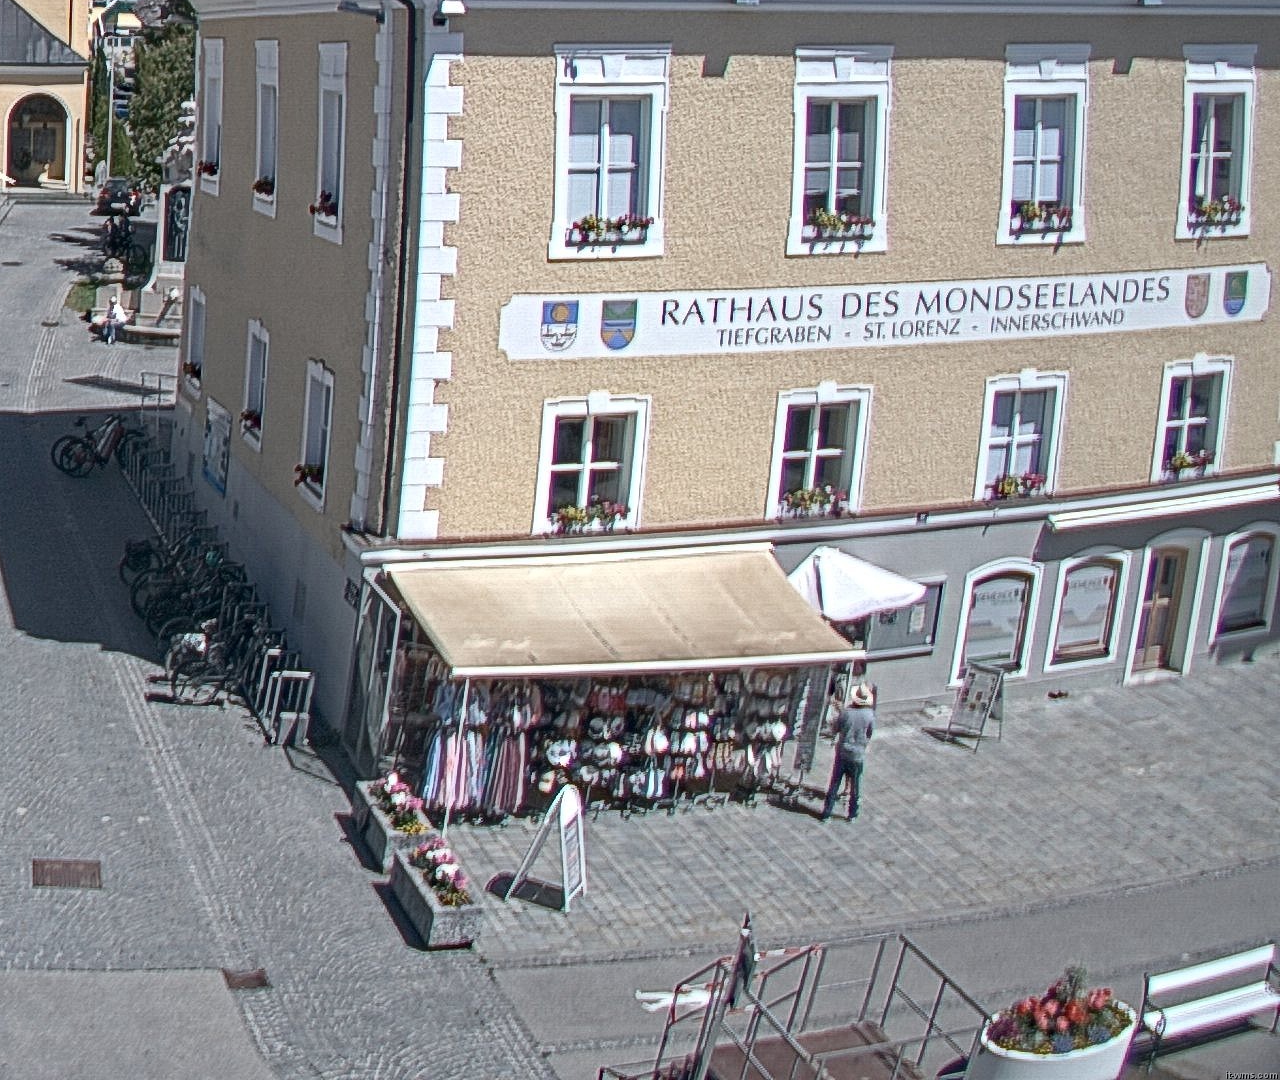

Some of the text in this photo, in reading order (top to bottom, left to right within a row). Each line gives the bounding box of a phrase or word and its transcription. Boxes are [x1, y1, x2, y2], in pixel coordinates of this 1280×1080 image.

[661, 276, 1170, 326] RATHAUS DES MONDSEELANDES
[716, 324, 833, 347] TIEFGRABEN
[863, 321, 886, 341] ST.
[891, 318, 961, 340] LORENZ
[990, 308, 1125, 334] INNERSCHWAND
